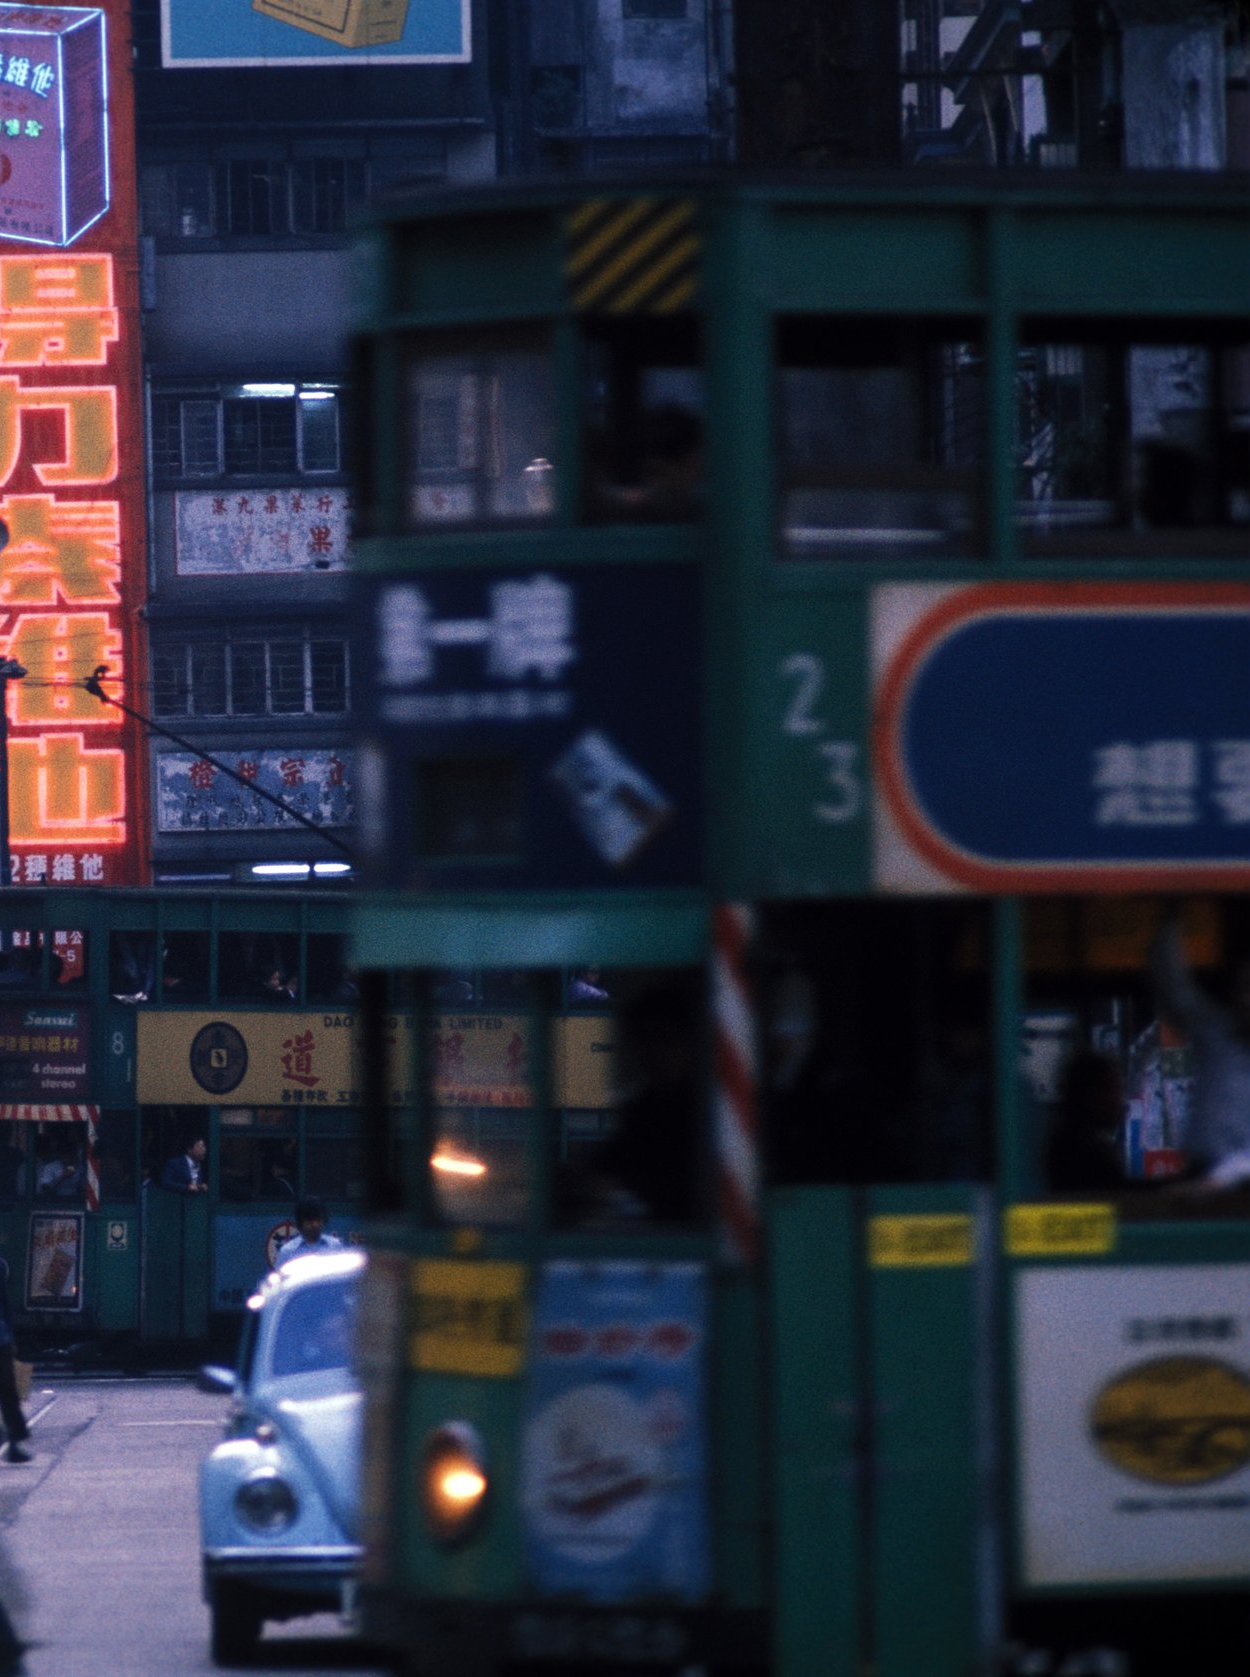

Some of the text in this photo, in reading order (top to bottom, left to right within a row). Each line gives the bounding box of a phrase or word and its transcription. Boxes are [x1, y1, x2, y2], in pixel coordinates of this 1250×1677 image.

[23, 1010, 77, 1027] Sansui
[41, 1062, 86, 1075] channel
[40, 1078, 77, 1089] stereo
